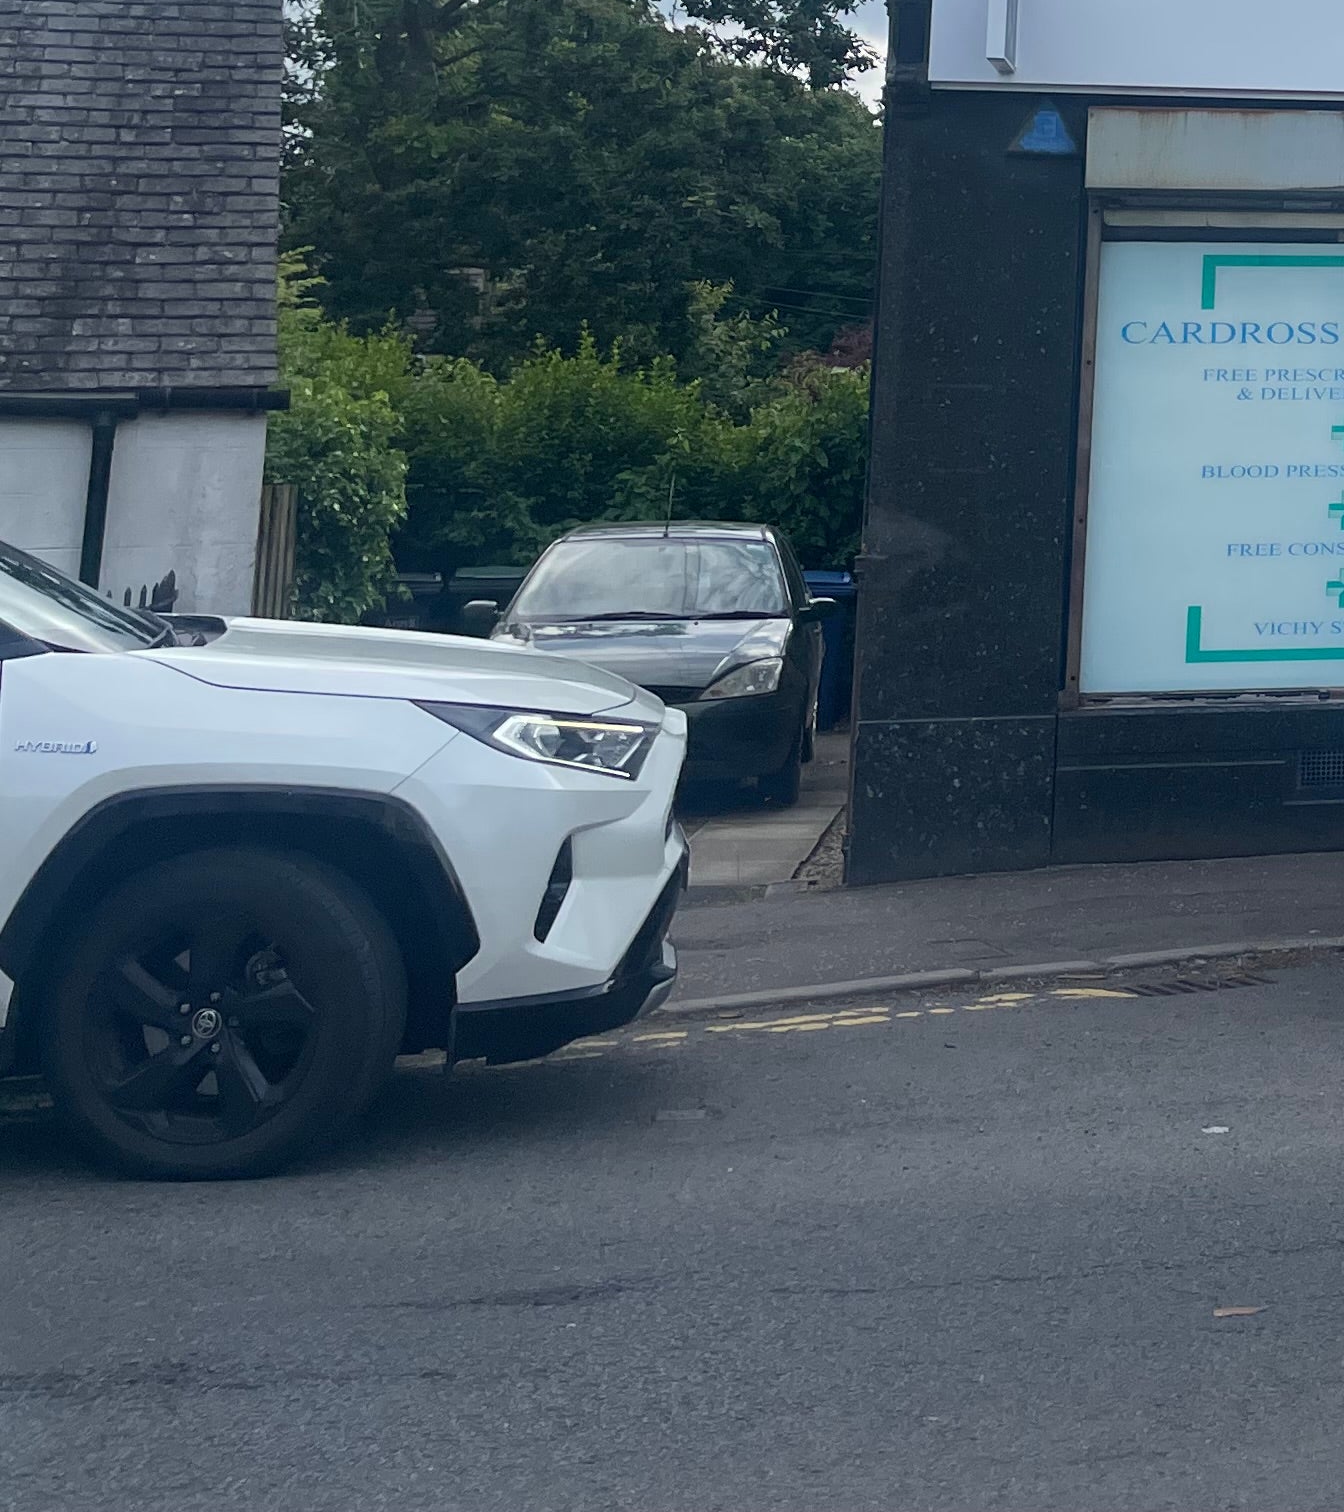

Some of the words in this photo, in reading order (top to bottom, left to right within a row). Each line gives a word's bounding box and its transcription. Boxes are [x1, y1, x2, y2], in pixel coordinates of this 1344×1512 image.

[1121, 321, 1340, 345] CARDROSS
[1203, 368, 1257, 382] FREE
[1236, 387, 1254, 401] &
[1201, 464, 1280, 479] BLOOD
[1226, 543, 1281, 557] FREE
[1254, 621, 1325, 636] VICHY
